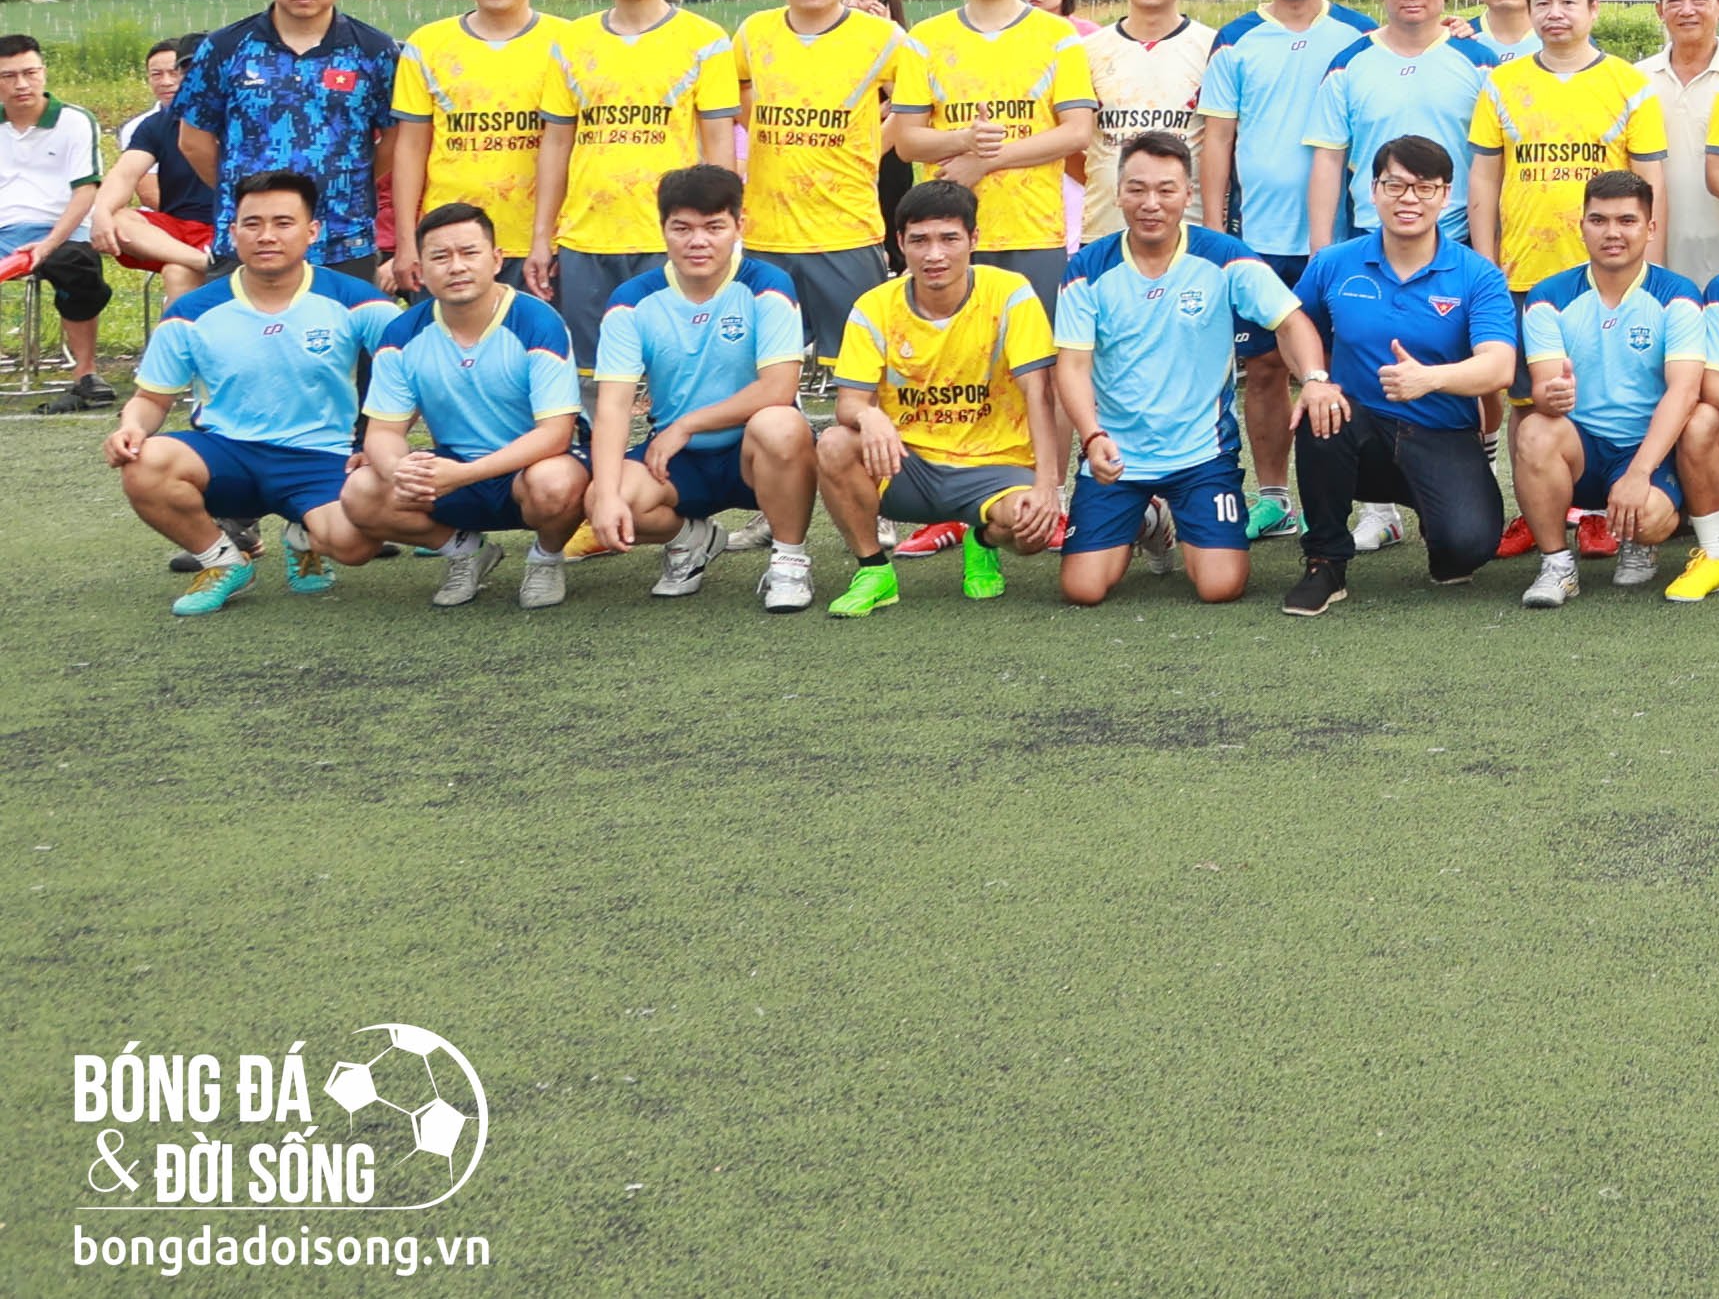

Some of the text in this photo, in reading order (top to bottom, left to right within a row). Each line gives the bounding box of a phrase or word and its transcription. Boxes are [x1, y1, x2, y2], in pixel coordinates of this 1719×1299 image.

[446, 110, 546, 133] KITSSPOR
[484, 136, 503, 151] 28
[609, 130, 628, 144] 28
[632, 129, 666, 144] 6789
[785, 129, 804, 146] 28
[808, 130, 846, 148] 6789
[1515, 142, 1607, 164] KKITSSPORT
[1519, 166, 1605, 183] 0911 28 678
[934, 409, 953, 424] 28
[1213, 492, 1238, 524] 10
